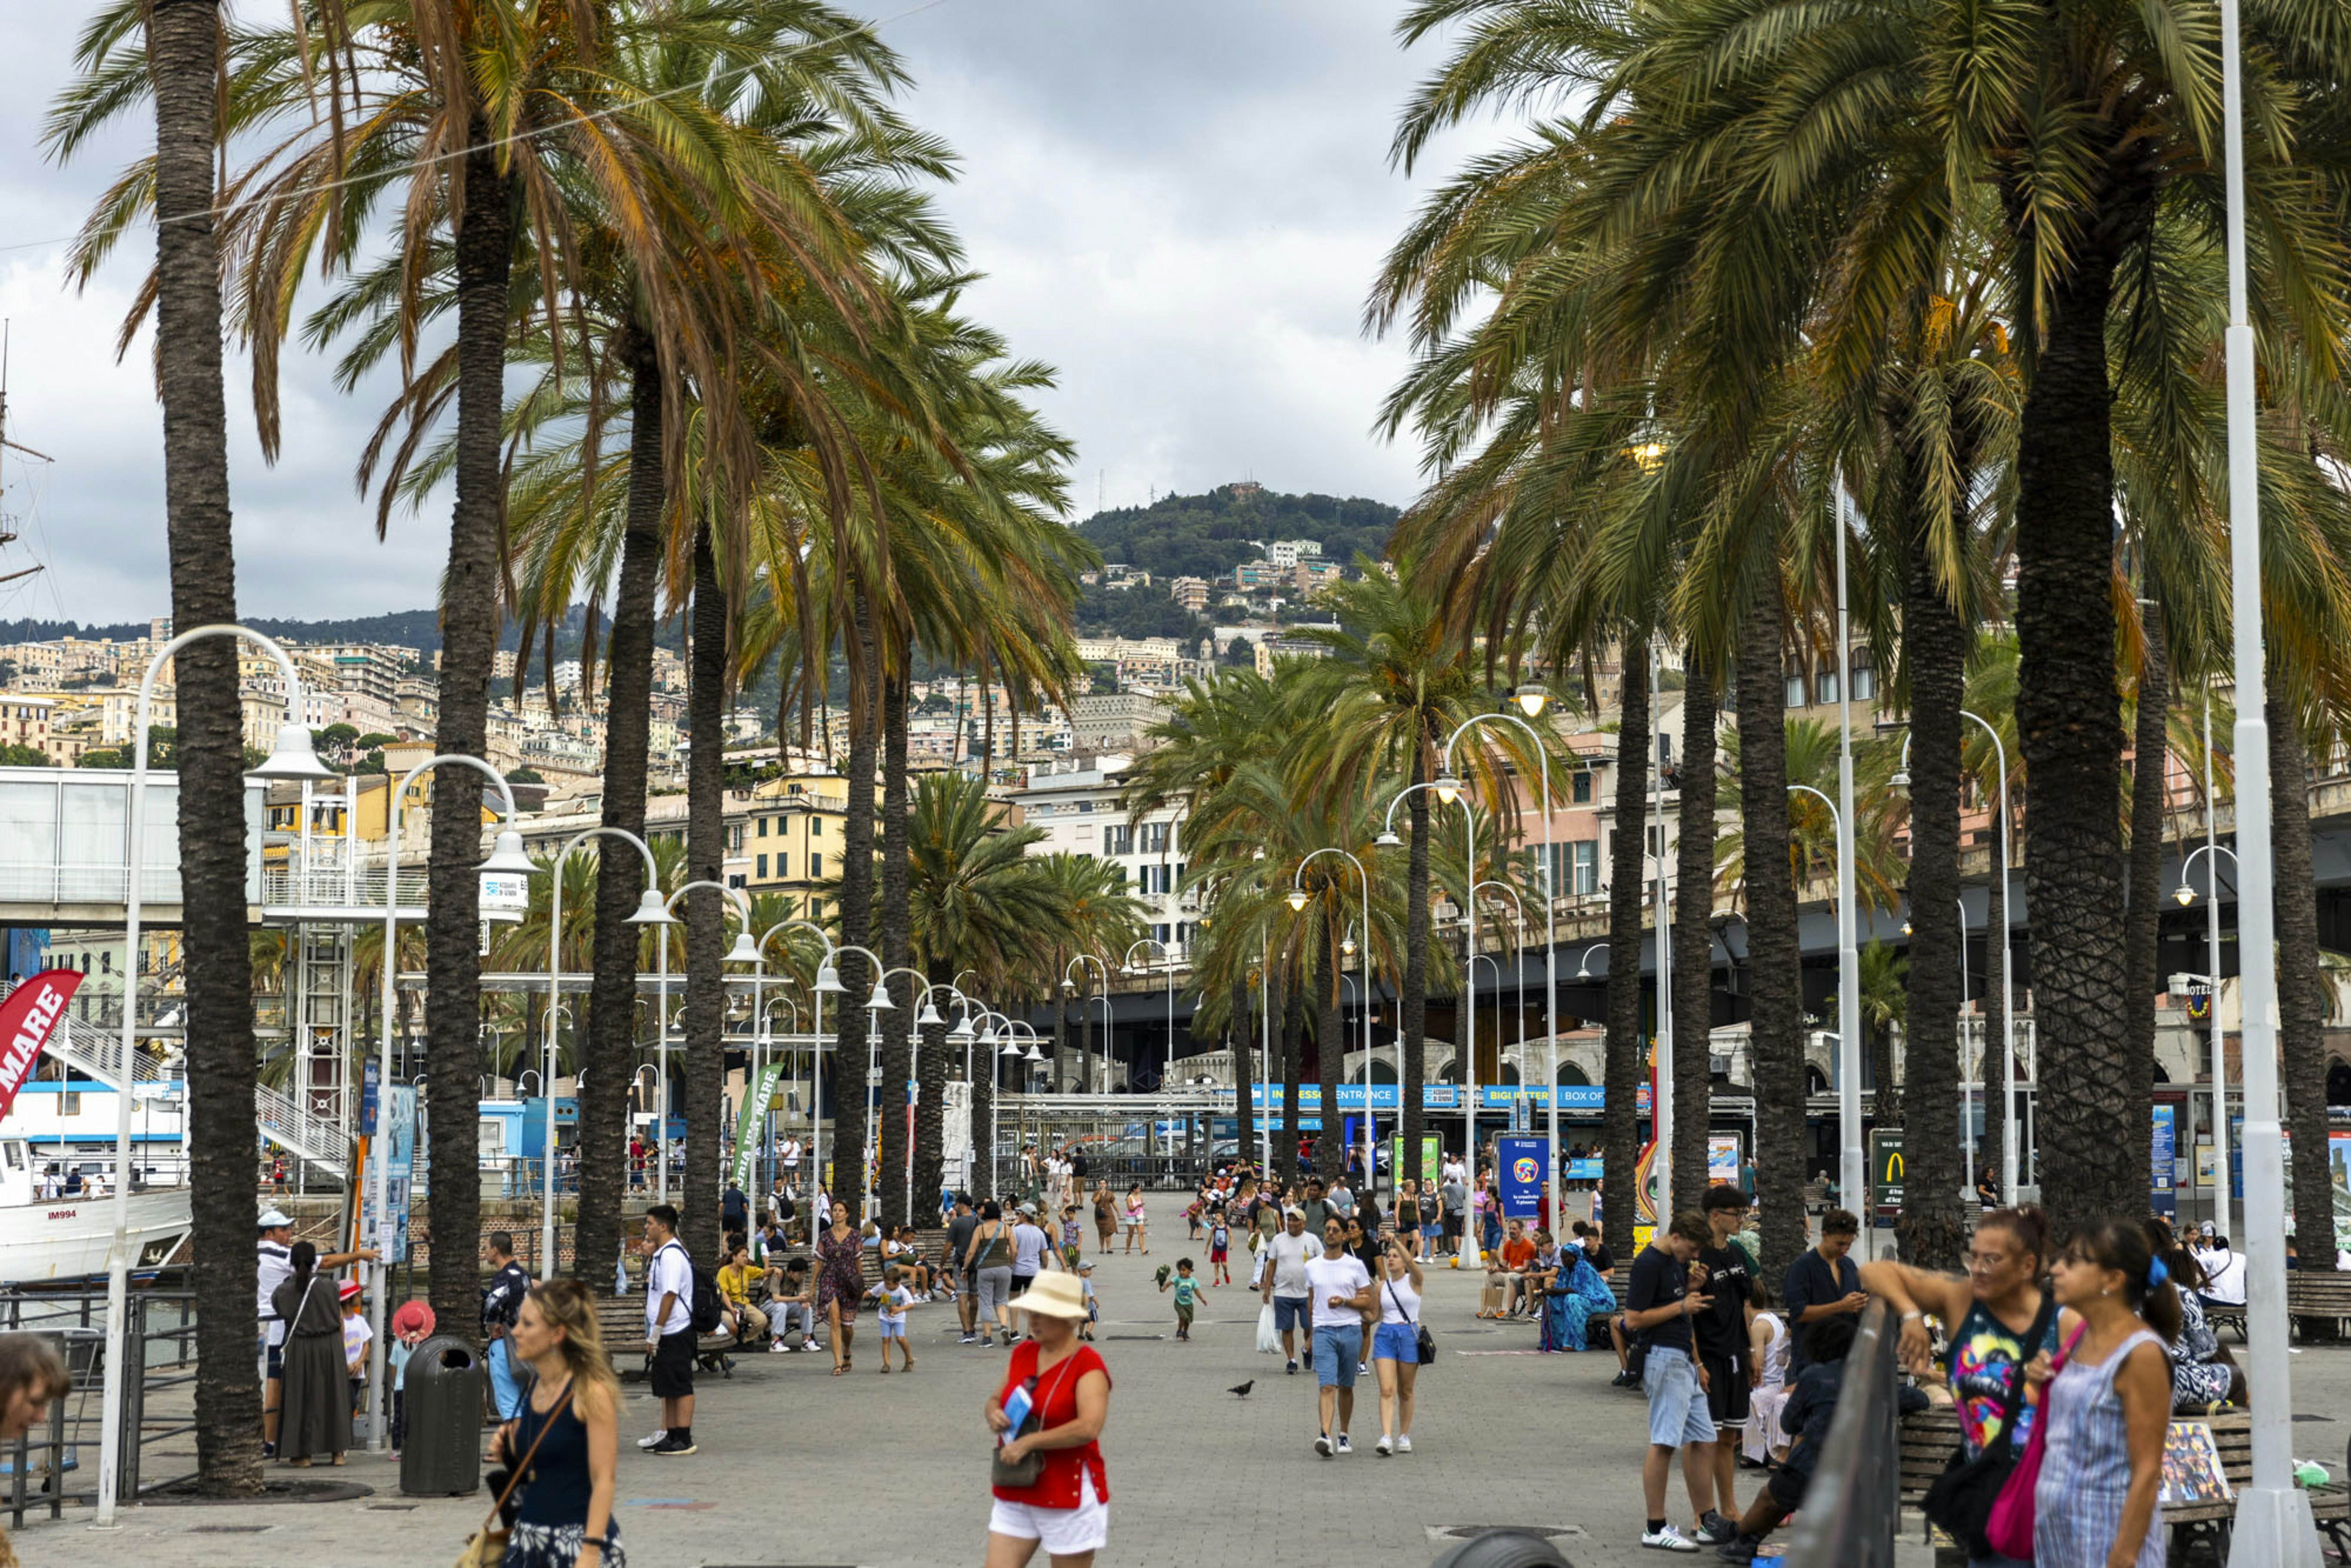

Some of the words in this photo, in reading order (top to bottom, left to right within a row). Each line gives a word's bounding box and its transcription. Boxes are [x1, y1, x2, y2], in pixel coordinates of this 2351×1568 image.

[0, 983, 64, 1094] MARE
[756, 1070, 777, 1116] MARE
[1272, 1091, 1322, 1099] INESS
[1565, 1091, 1587, 1100] BOX
[1590, 1091, 1605, 1100] OF
[48, 1209, 76, 1219] IM994
